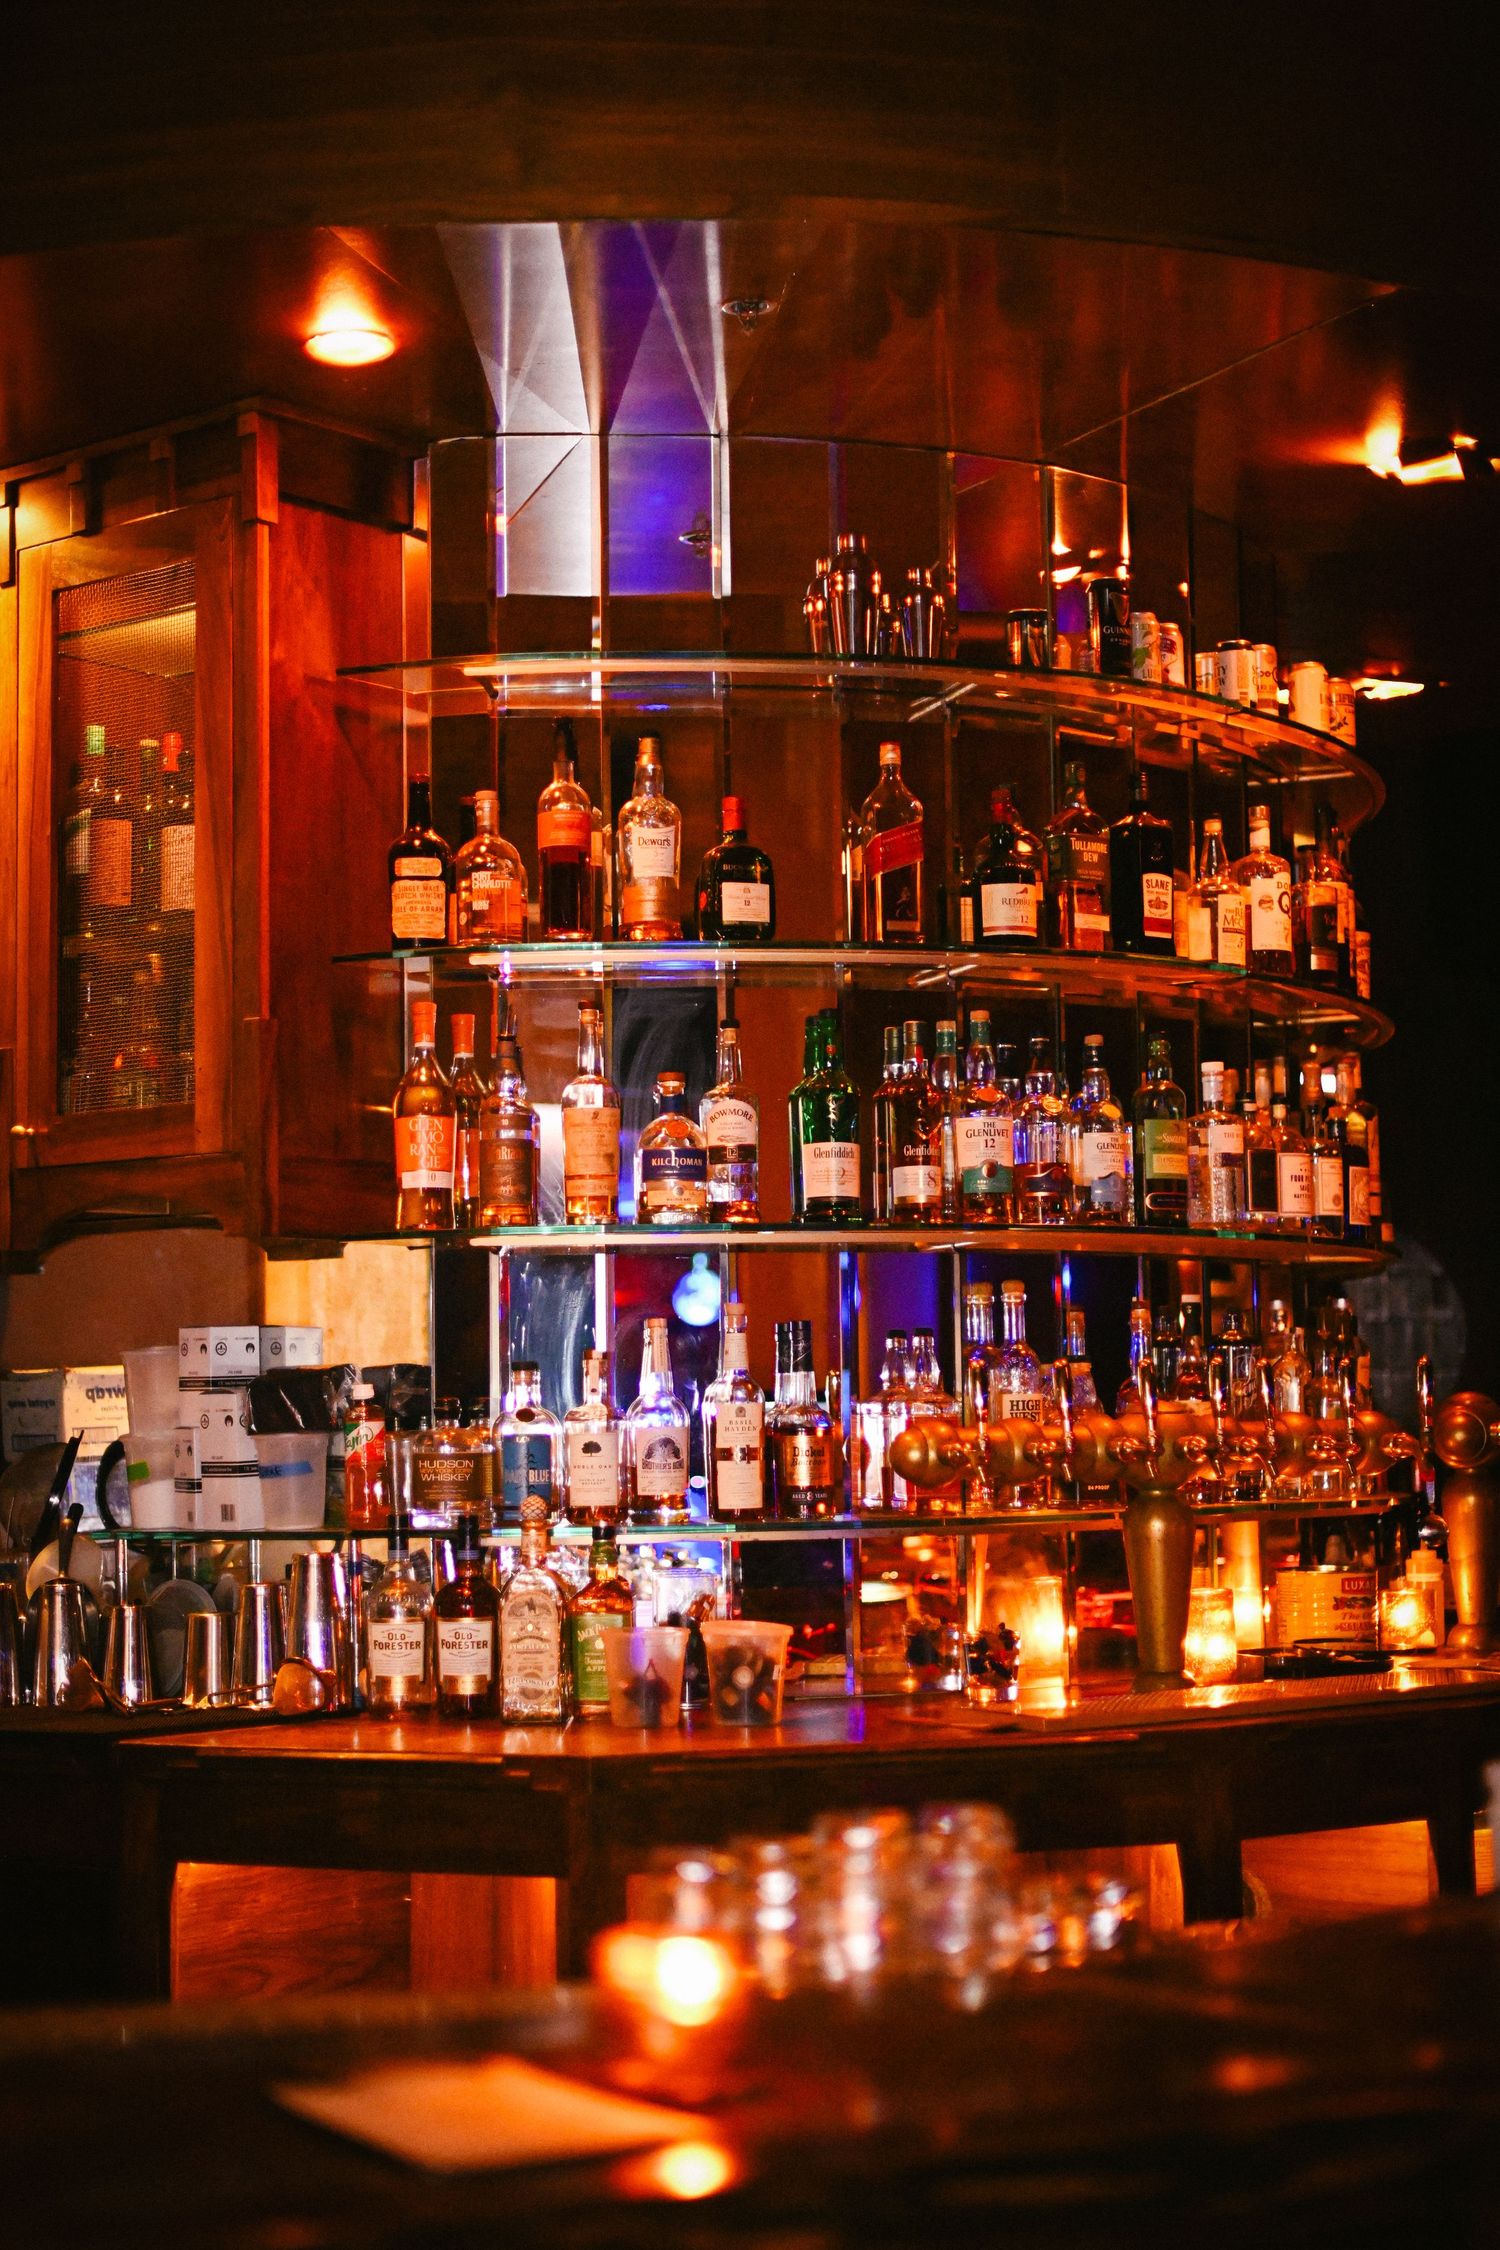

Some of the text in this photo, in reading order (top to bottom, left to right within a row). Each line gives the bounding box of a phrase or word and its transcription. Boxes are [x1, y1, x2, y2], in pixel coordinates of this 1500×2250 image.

[1083, 852, 1099, 862] DEW
[472, 870, 491, 880] PORT
[1146, 879, 1170, 891] SLANE
[744, 899, 751, 907] 12
[709, 1108, 754, 1123] BOWMORE
[408, 1118, 443, 1131] GLEN
[965, 1128, 1009, 1139] GLENLIVET
[984, 1138, 996, 1148] 12
[410, 1144, 437, 1156] RAN
[728, 1148, 738, 1156] 12
[813, 1147, 855, 1159] Glenfiddich
[420, 1156, 441, 1169] GIE
[793, 1446, 825, 1457] Dickel
[418, 1459, 474, 1469] HUDSON
[420, 1473, 471, 1481] WHISKEY
[528, 1469, 550, 1482] BLUE
[806, 1491, 814, 1501] 8
[387, 1632, 406, 1641] OLD
[454, 1631, 473, 1640] OLD
[374, 1640, 421, 1650] FORESTER
[441, 1639, 489, 1650] FORESTER
